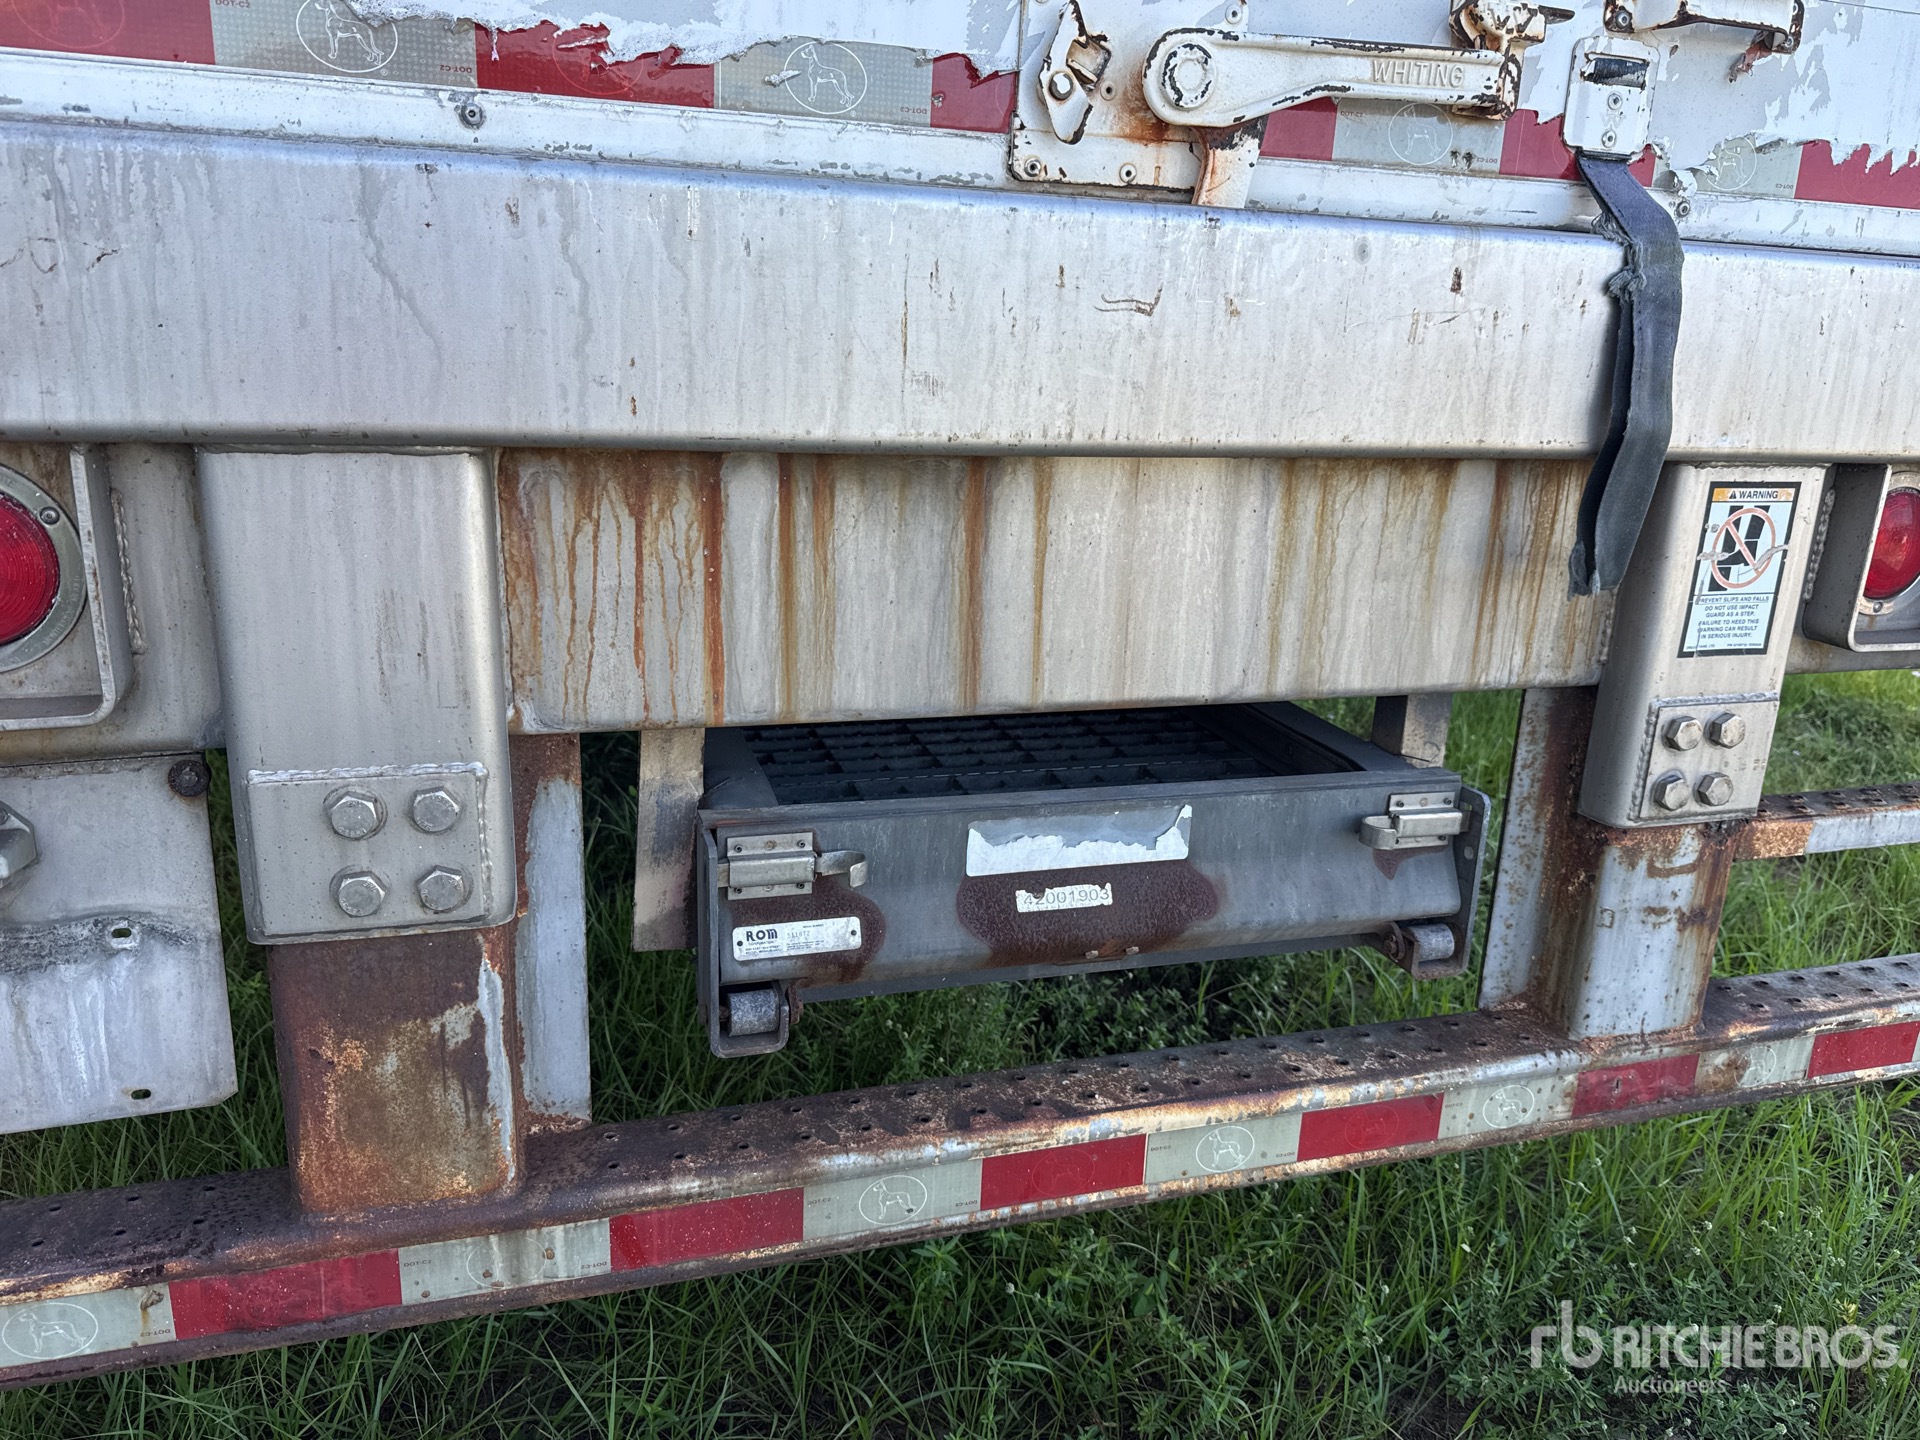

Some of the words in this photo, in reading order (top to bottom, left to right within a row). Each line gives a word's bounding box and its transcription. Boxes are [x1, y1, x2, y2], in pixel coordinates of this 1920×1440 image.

[440, 64, 473, 74] DOT-C2
[1371, 60, 1464, 88] WHITING
[900, 106, 928, 115] DOT-C2
[1739, 490, 1778, 499] WARNING
